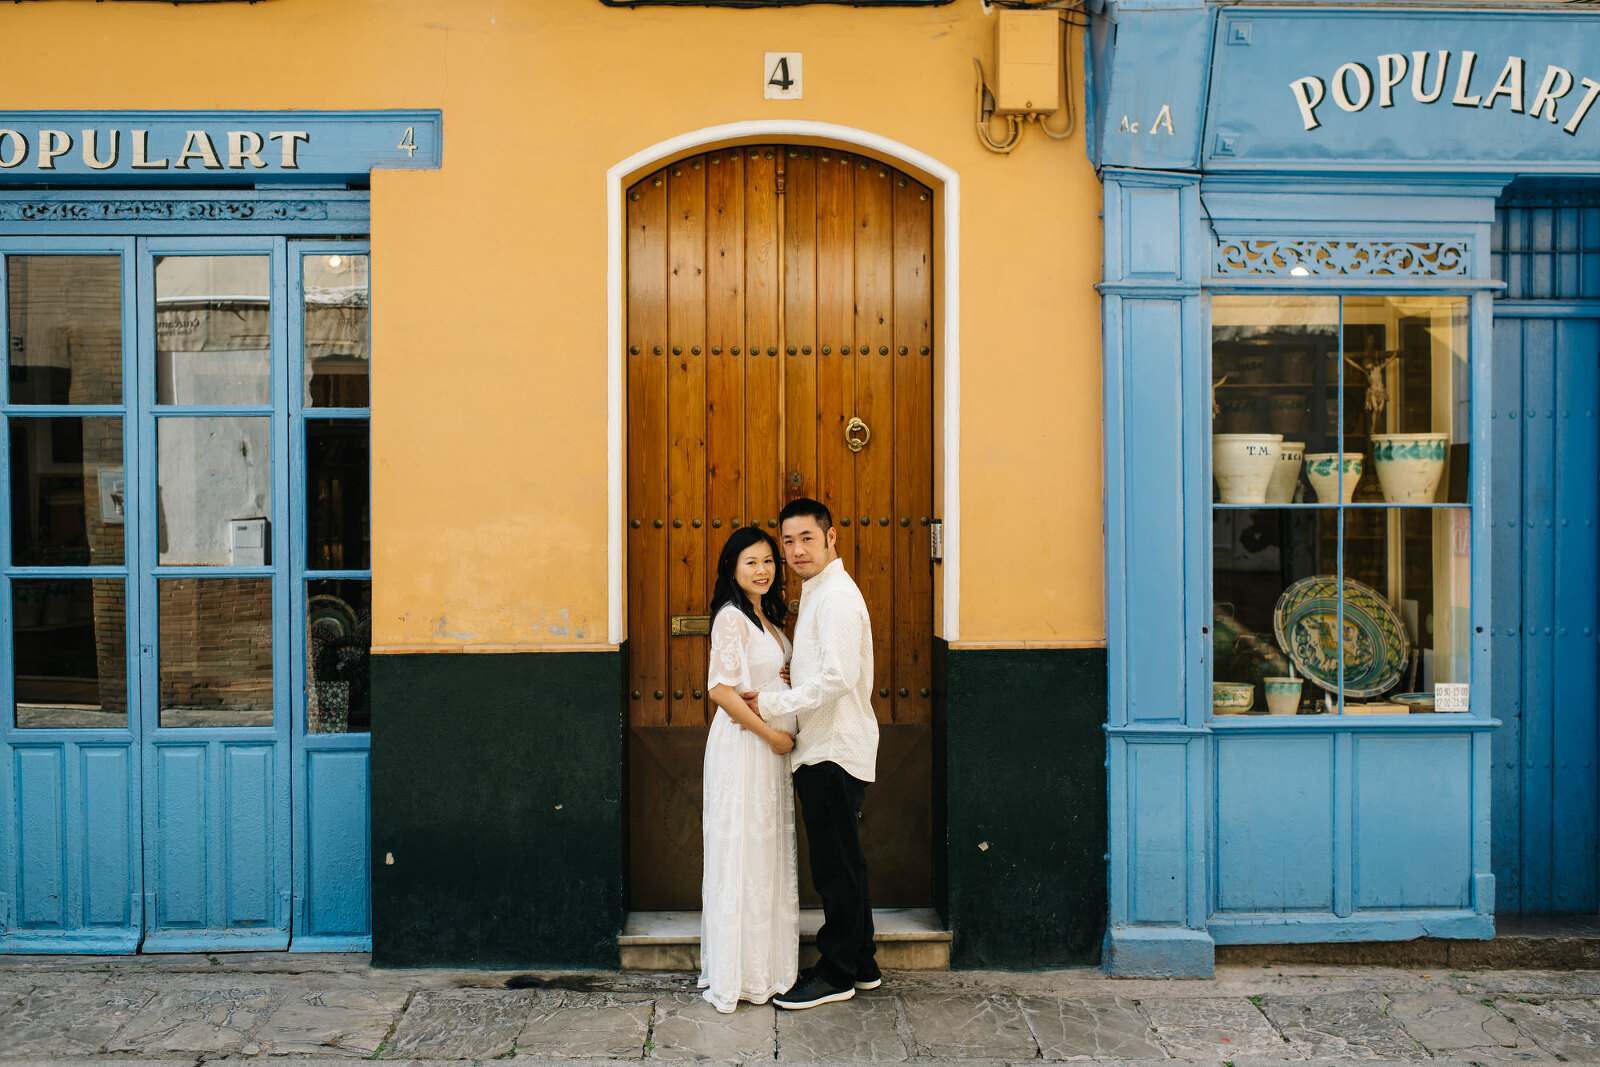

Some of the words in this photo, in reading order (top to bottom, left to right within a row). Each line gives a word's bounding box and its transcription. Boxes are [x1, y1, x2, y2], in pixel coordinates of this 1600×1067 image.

[768, 57, 794, 90] 4
[1289, 50, 1600, 136] POPULART
[397, 126, 419, 157] 4
